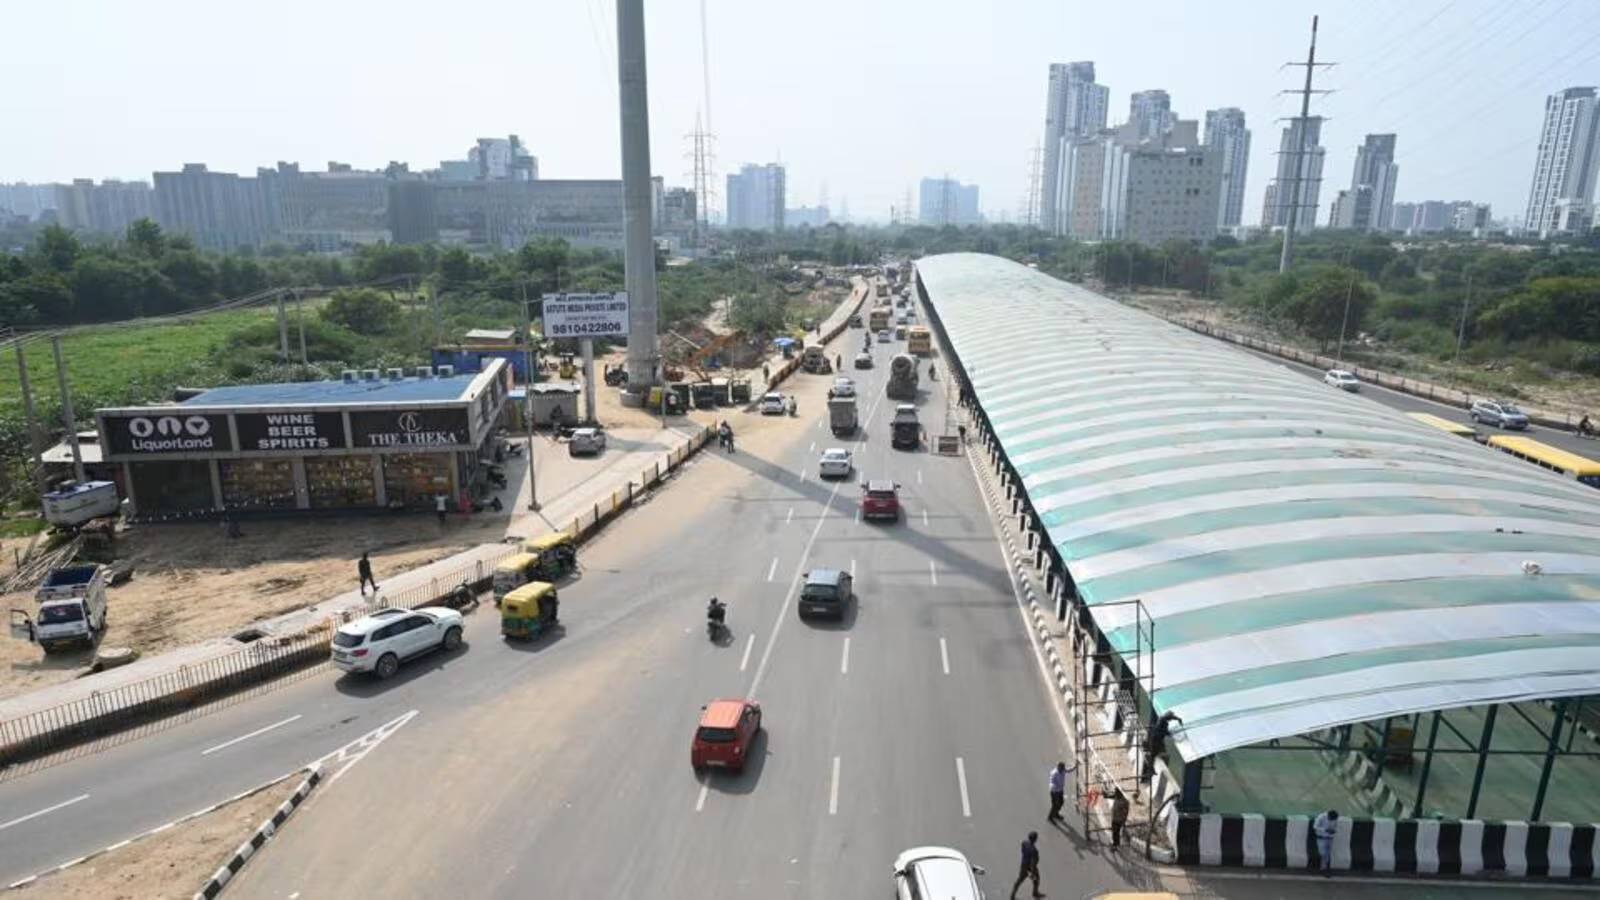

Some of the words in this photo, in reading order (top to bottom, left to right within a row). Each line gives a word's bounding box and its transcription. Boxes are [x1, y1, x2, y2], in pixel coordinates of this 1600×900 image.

[585, 303, 606, 312] PRIVATE
[607, 302, 626, 311] LIMITED
[266, 414, 315, 425] WINE
[268, 426, 317, 437] BEER
[258, 437, 329, 449] SPIRITS
[368, 433, 400, 446] THE
[404, 432, 458, 445] THEKA
